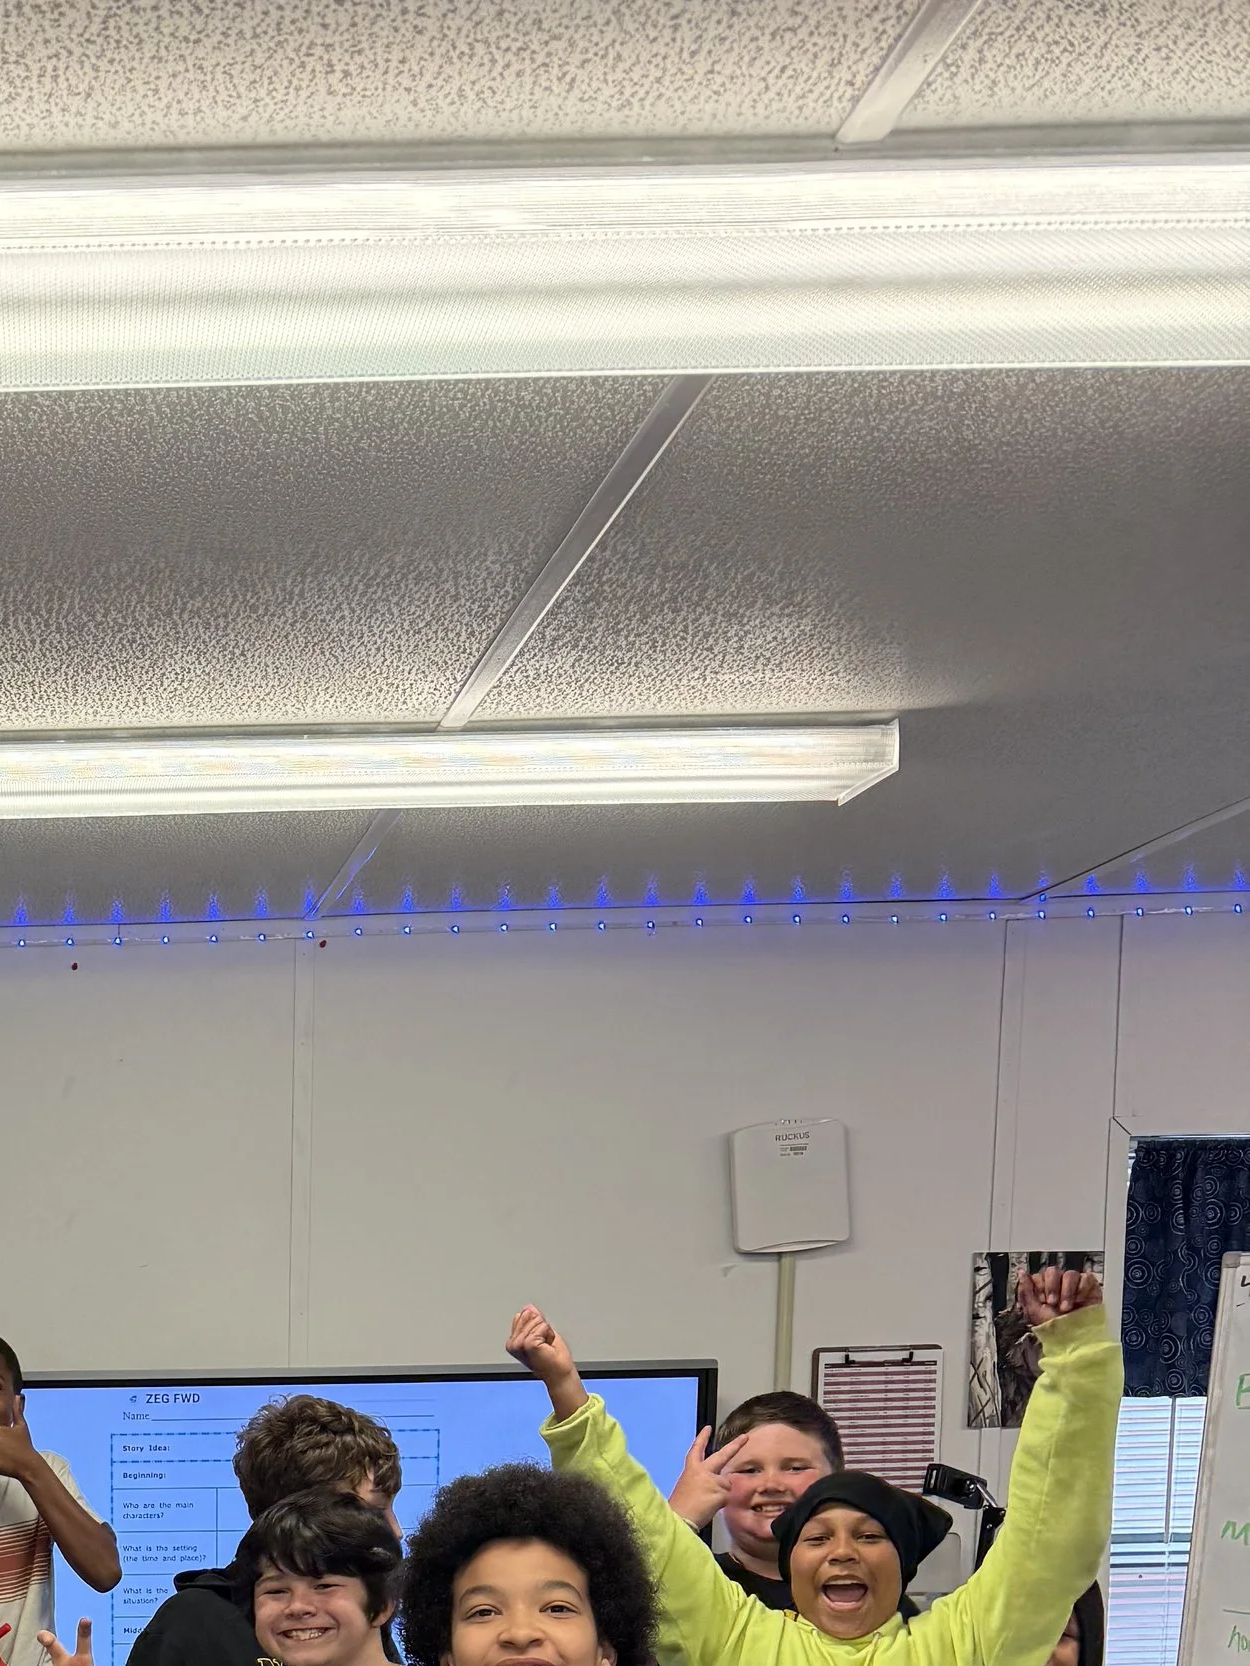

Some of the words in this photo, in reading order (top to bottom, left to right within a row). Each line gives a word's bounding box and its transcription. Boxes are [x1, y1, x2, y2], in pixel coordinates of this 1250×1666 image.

[775, 1131, 810, 1141] RUCKUS
[146, 1393, 170, 1404] ZEG
[173, 1393, 200, 1404] FWD
[122, 1411, 150, 1421] Name
[123, 1445, 144, 1453] Story
[149, 1444, 170, 1452] Idea:
[122, 1472, 166, 1480] Beginning:
[172, 1545, 197, 1553] setting
